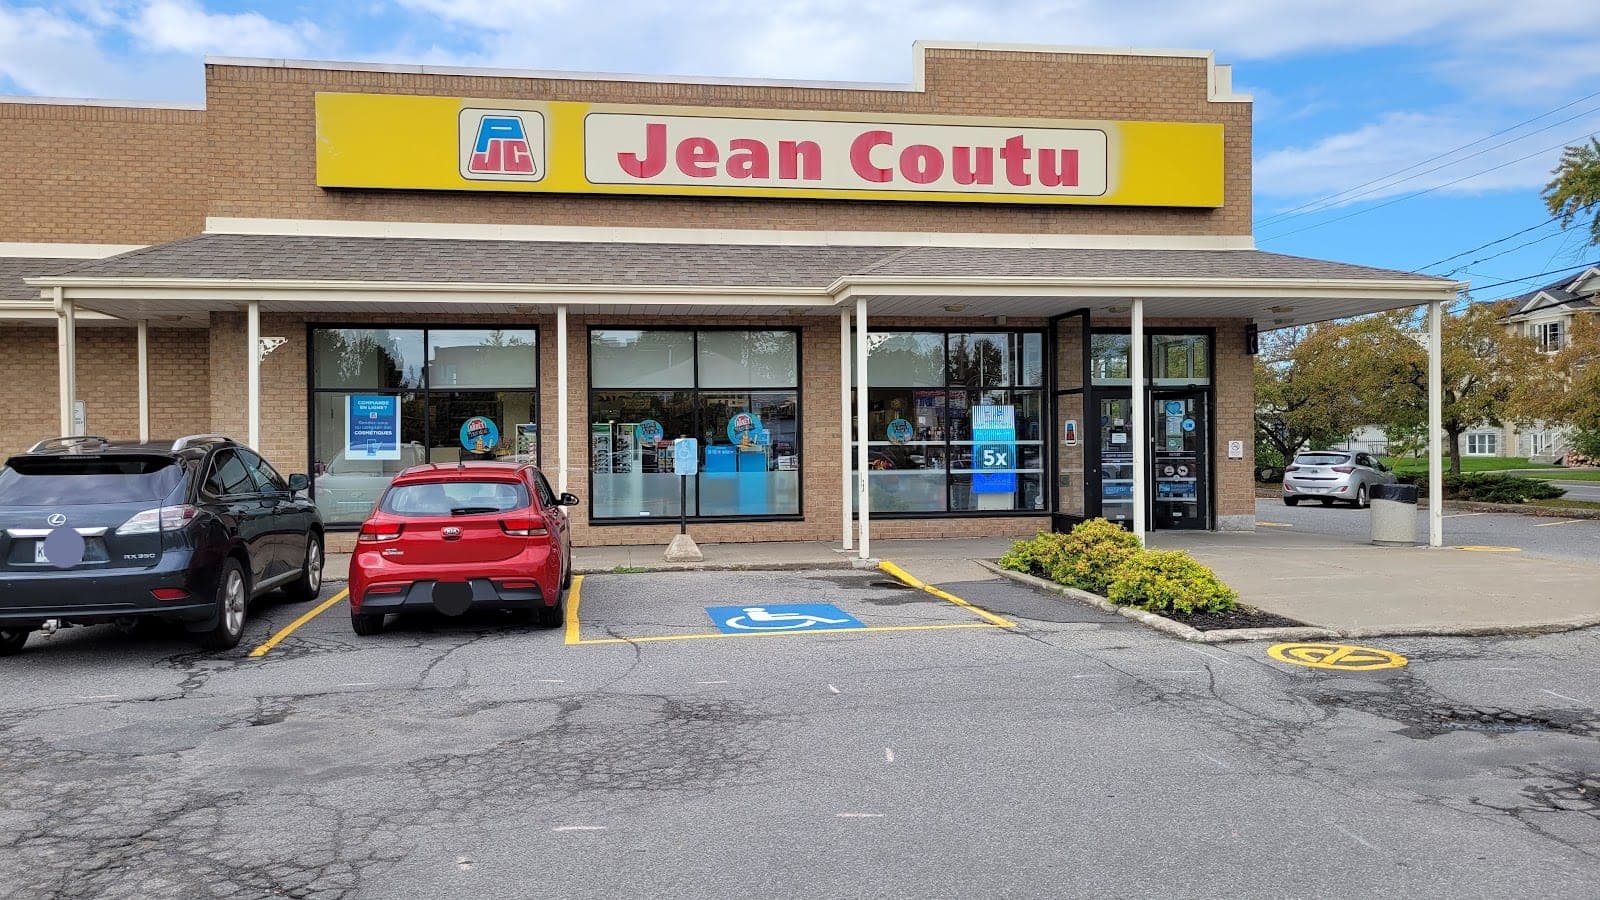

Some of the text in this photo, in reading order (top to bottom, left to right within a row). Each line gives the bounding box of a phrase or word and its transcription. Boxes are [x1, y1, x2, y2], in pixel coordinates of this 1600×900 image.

[617, 123, 1079, 187] Jean Coutu
[983, 449, 1008, 466] 5x
